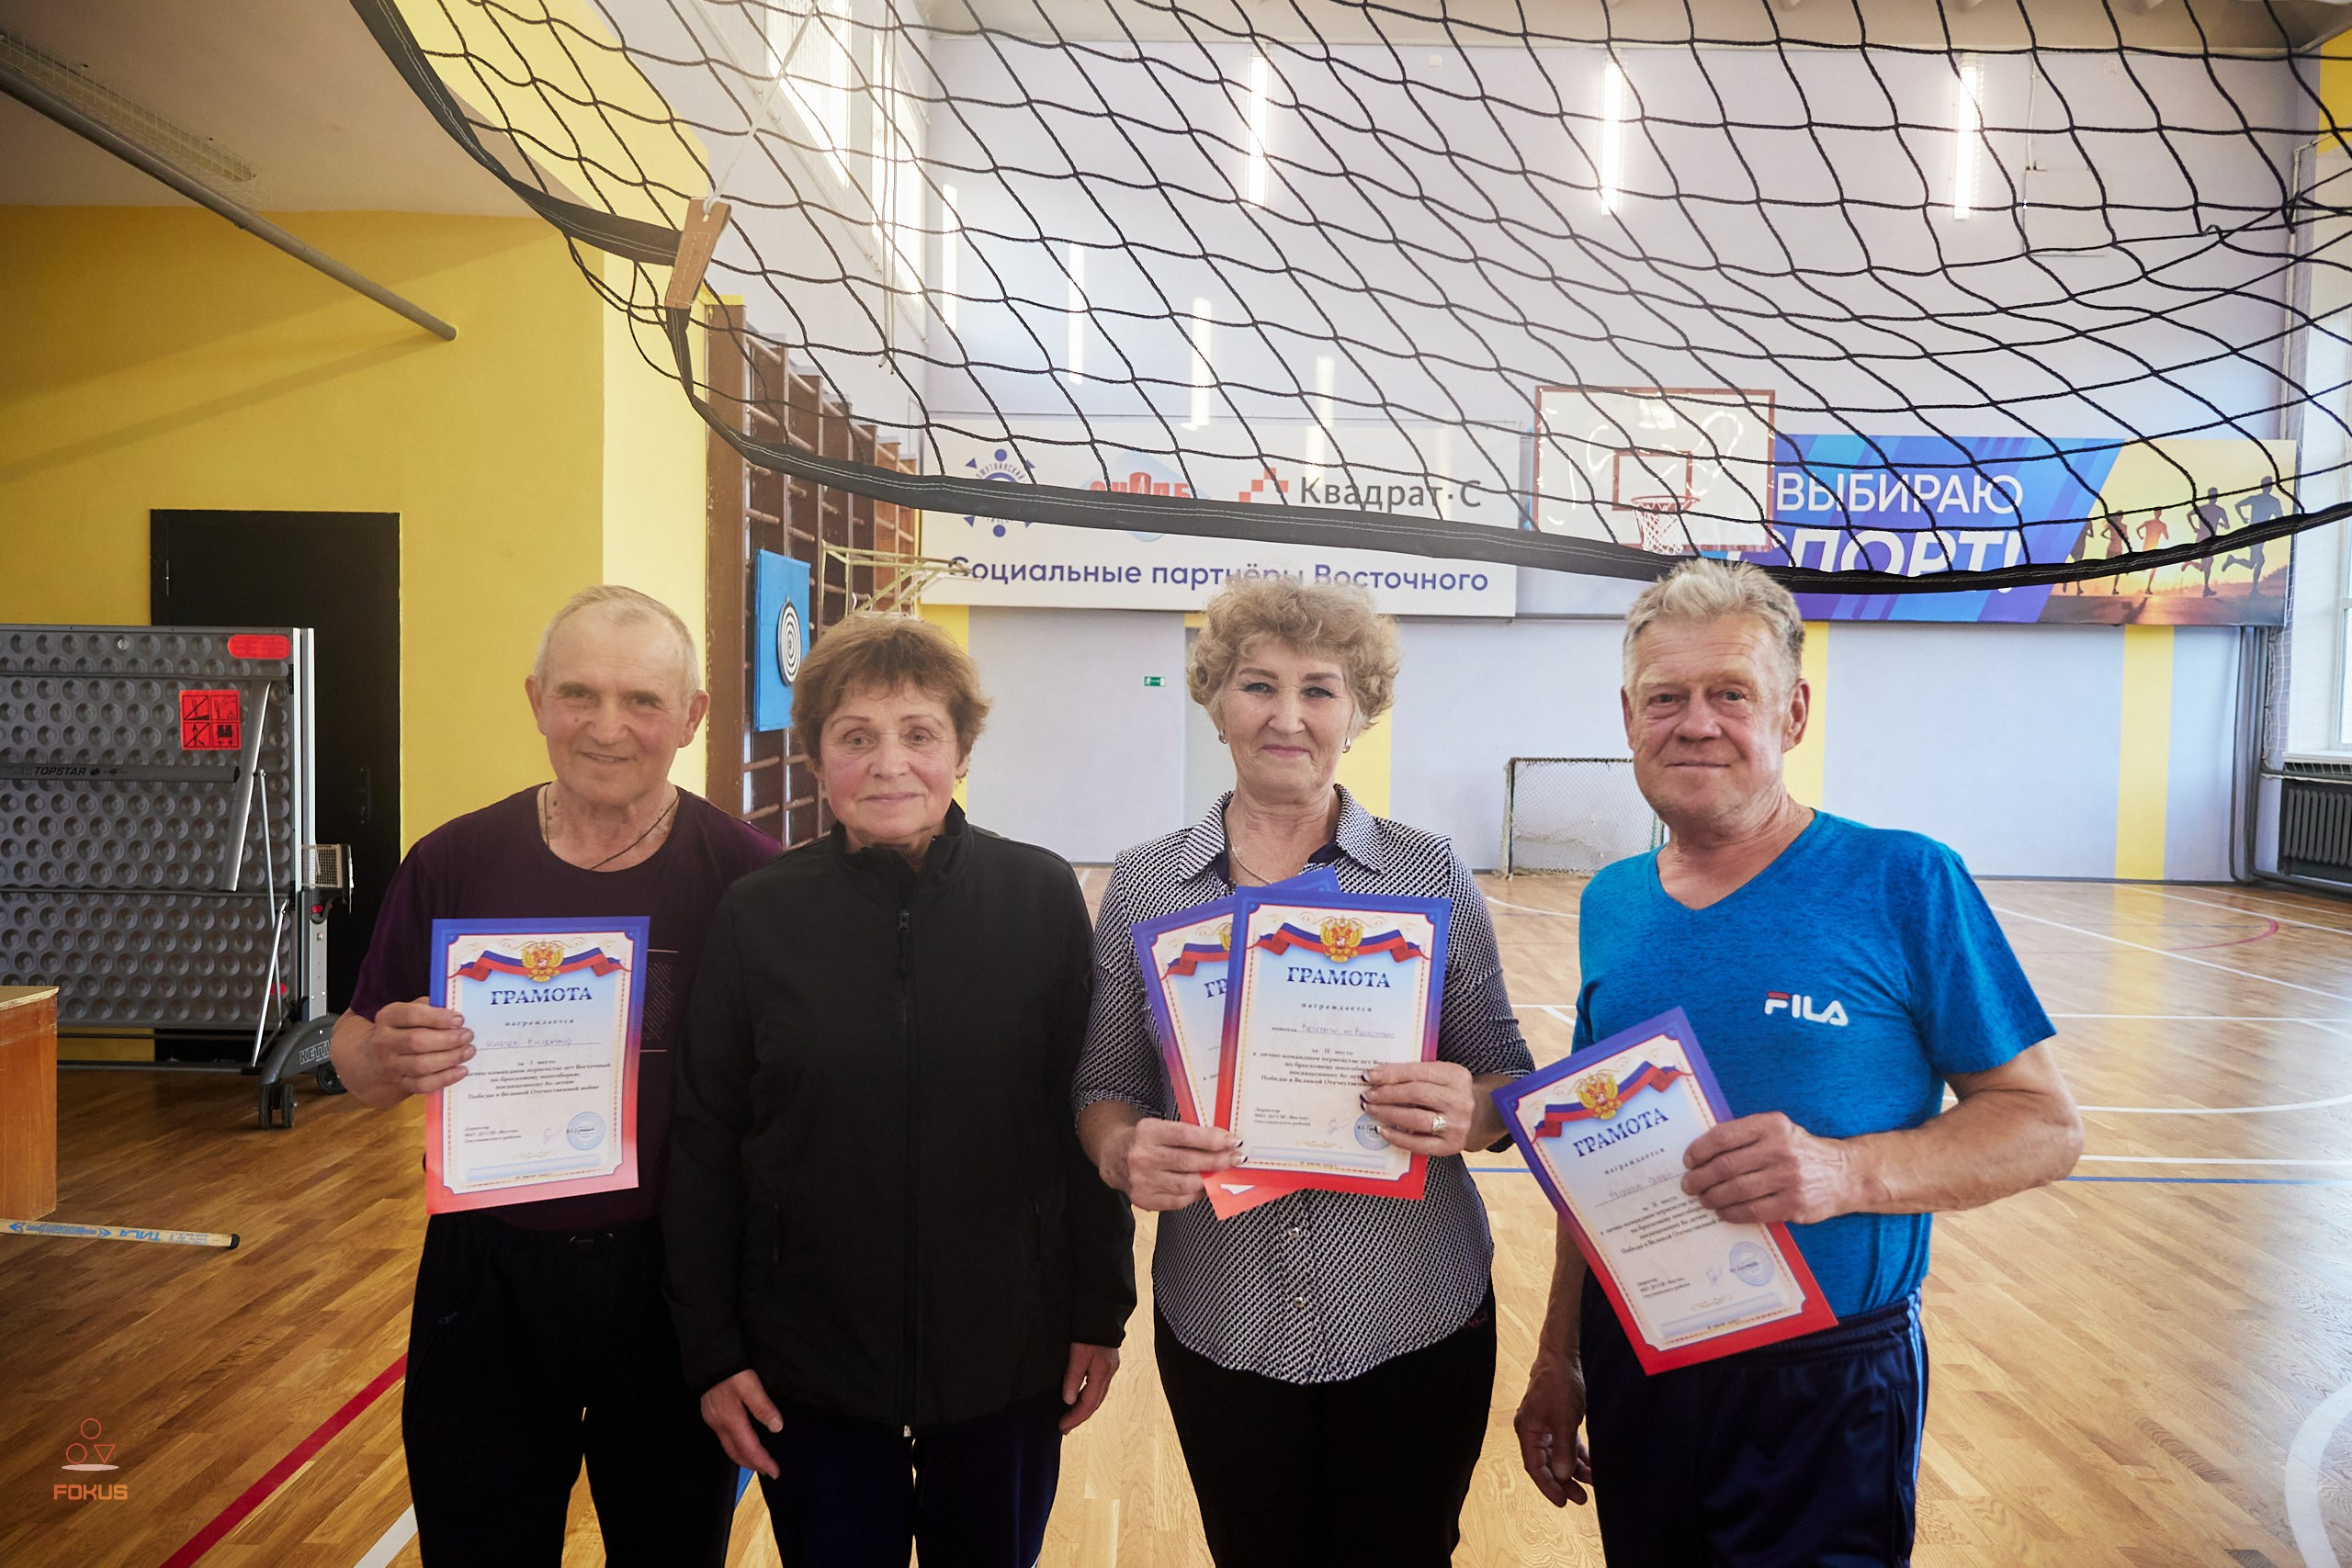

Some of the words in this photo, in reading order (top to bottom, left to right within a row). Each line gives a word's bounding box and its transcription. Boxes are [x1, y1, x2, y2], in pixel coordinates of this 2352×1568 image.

[1776, 473, 2023, 513] ВЫБИРАЮ
[948, 556, 1142, 585] Социальные
[1315, 564, 1488, 591] Восточного
[1727, 529, 2022, 592] ПОРТ!
[35, 766, 86, 776] TOPSTAR
[1287, 966, 1391, 988] ГРАМОТА
[491, 987, 593, 1005] ГРАМОТА
[1301, 1002, 1373, 1012] награждается
[1765, 991, 1849, 1026] FILA
[1572, 1108, 1669, 1157] ГРАМОТА
